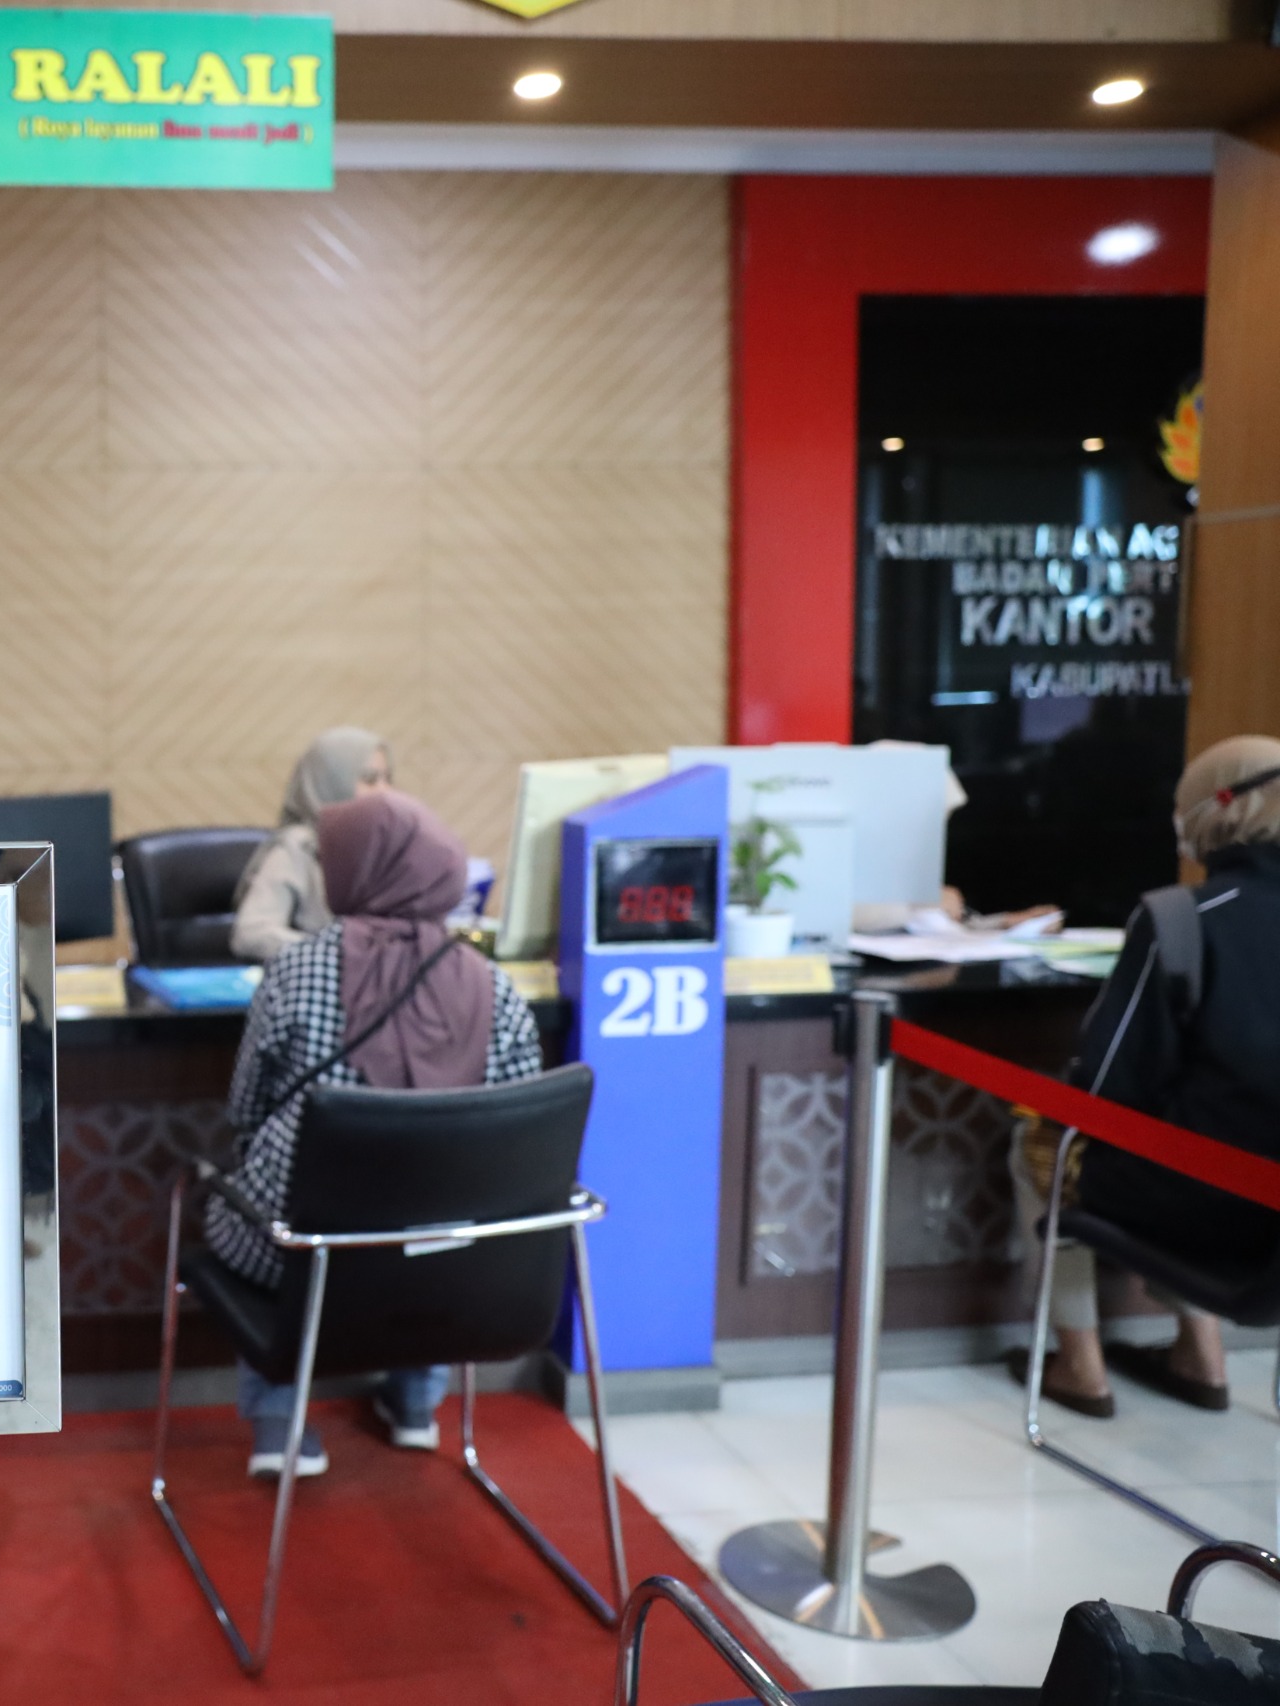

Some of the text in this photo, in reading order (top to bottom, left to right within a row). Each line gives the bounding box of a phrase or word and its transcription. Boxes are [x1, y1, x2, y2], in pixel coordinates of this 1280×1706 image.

[11, 48, 322, 107] RALALI
[960, 596, 1154, 647] KANTOR
[600, 965, 709, 1037] 2B
